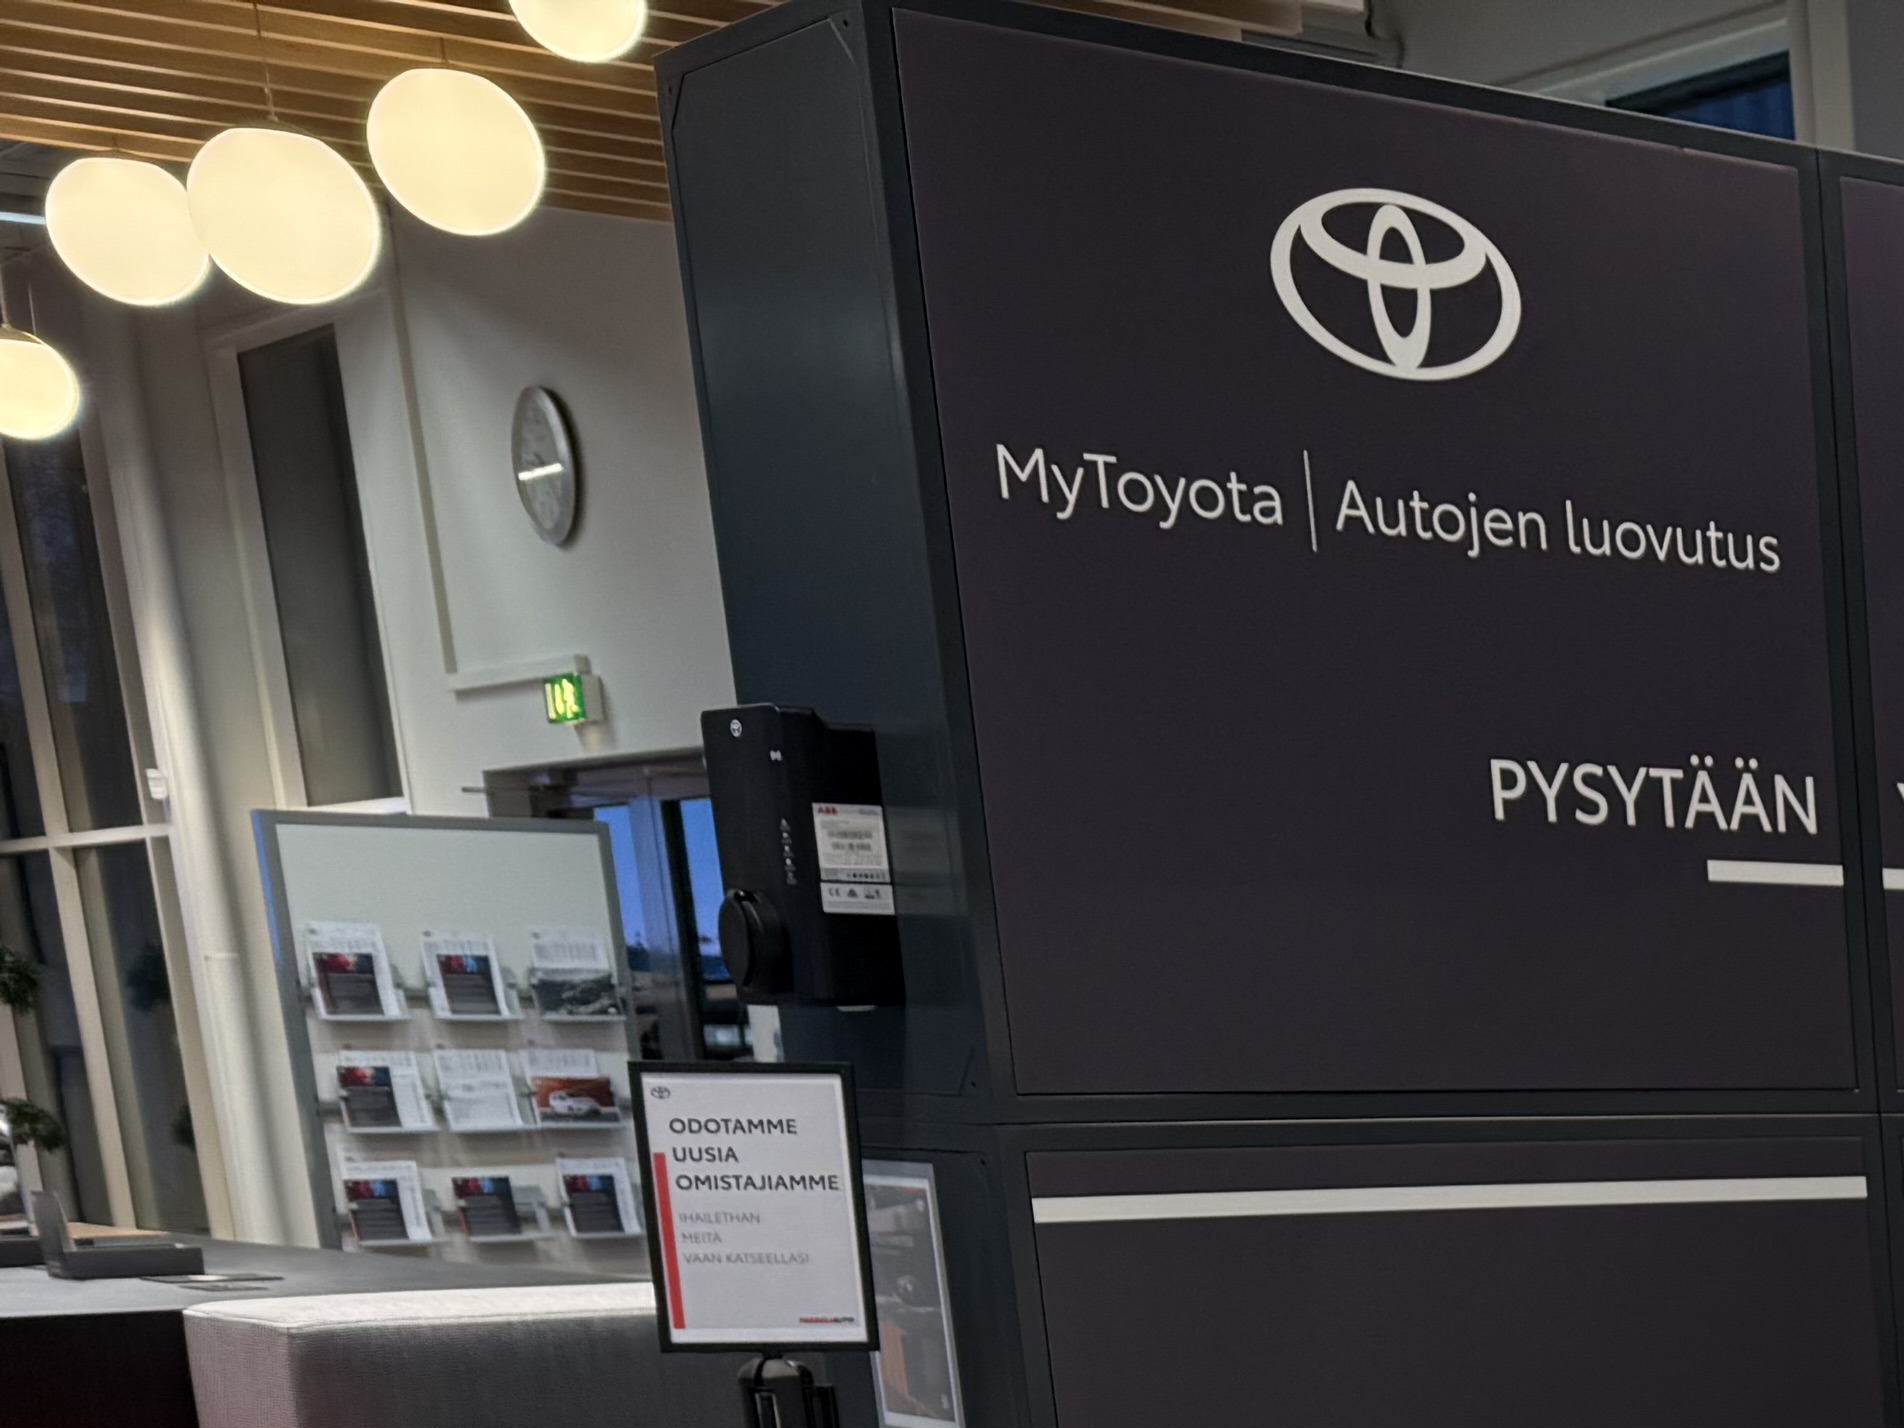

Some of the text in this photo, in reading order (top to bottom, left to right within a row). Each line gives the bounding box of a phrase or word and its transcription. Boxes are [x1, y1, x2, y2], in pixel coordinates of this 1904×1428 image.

[996, 442, 1781, 574] MyToyota Autojen luovutus
[1490, 755, 1818, 836] PYSYTÄÄN
[668, 1118, 798, 1135] ODOTAMME
[673, 1146, 739, 1163] UUSIA
[675, 1174, 840, 1192] OMISTAJIAMME
